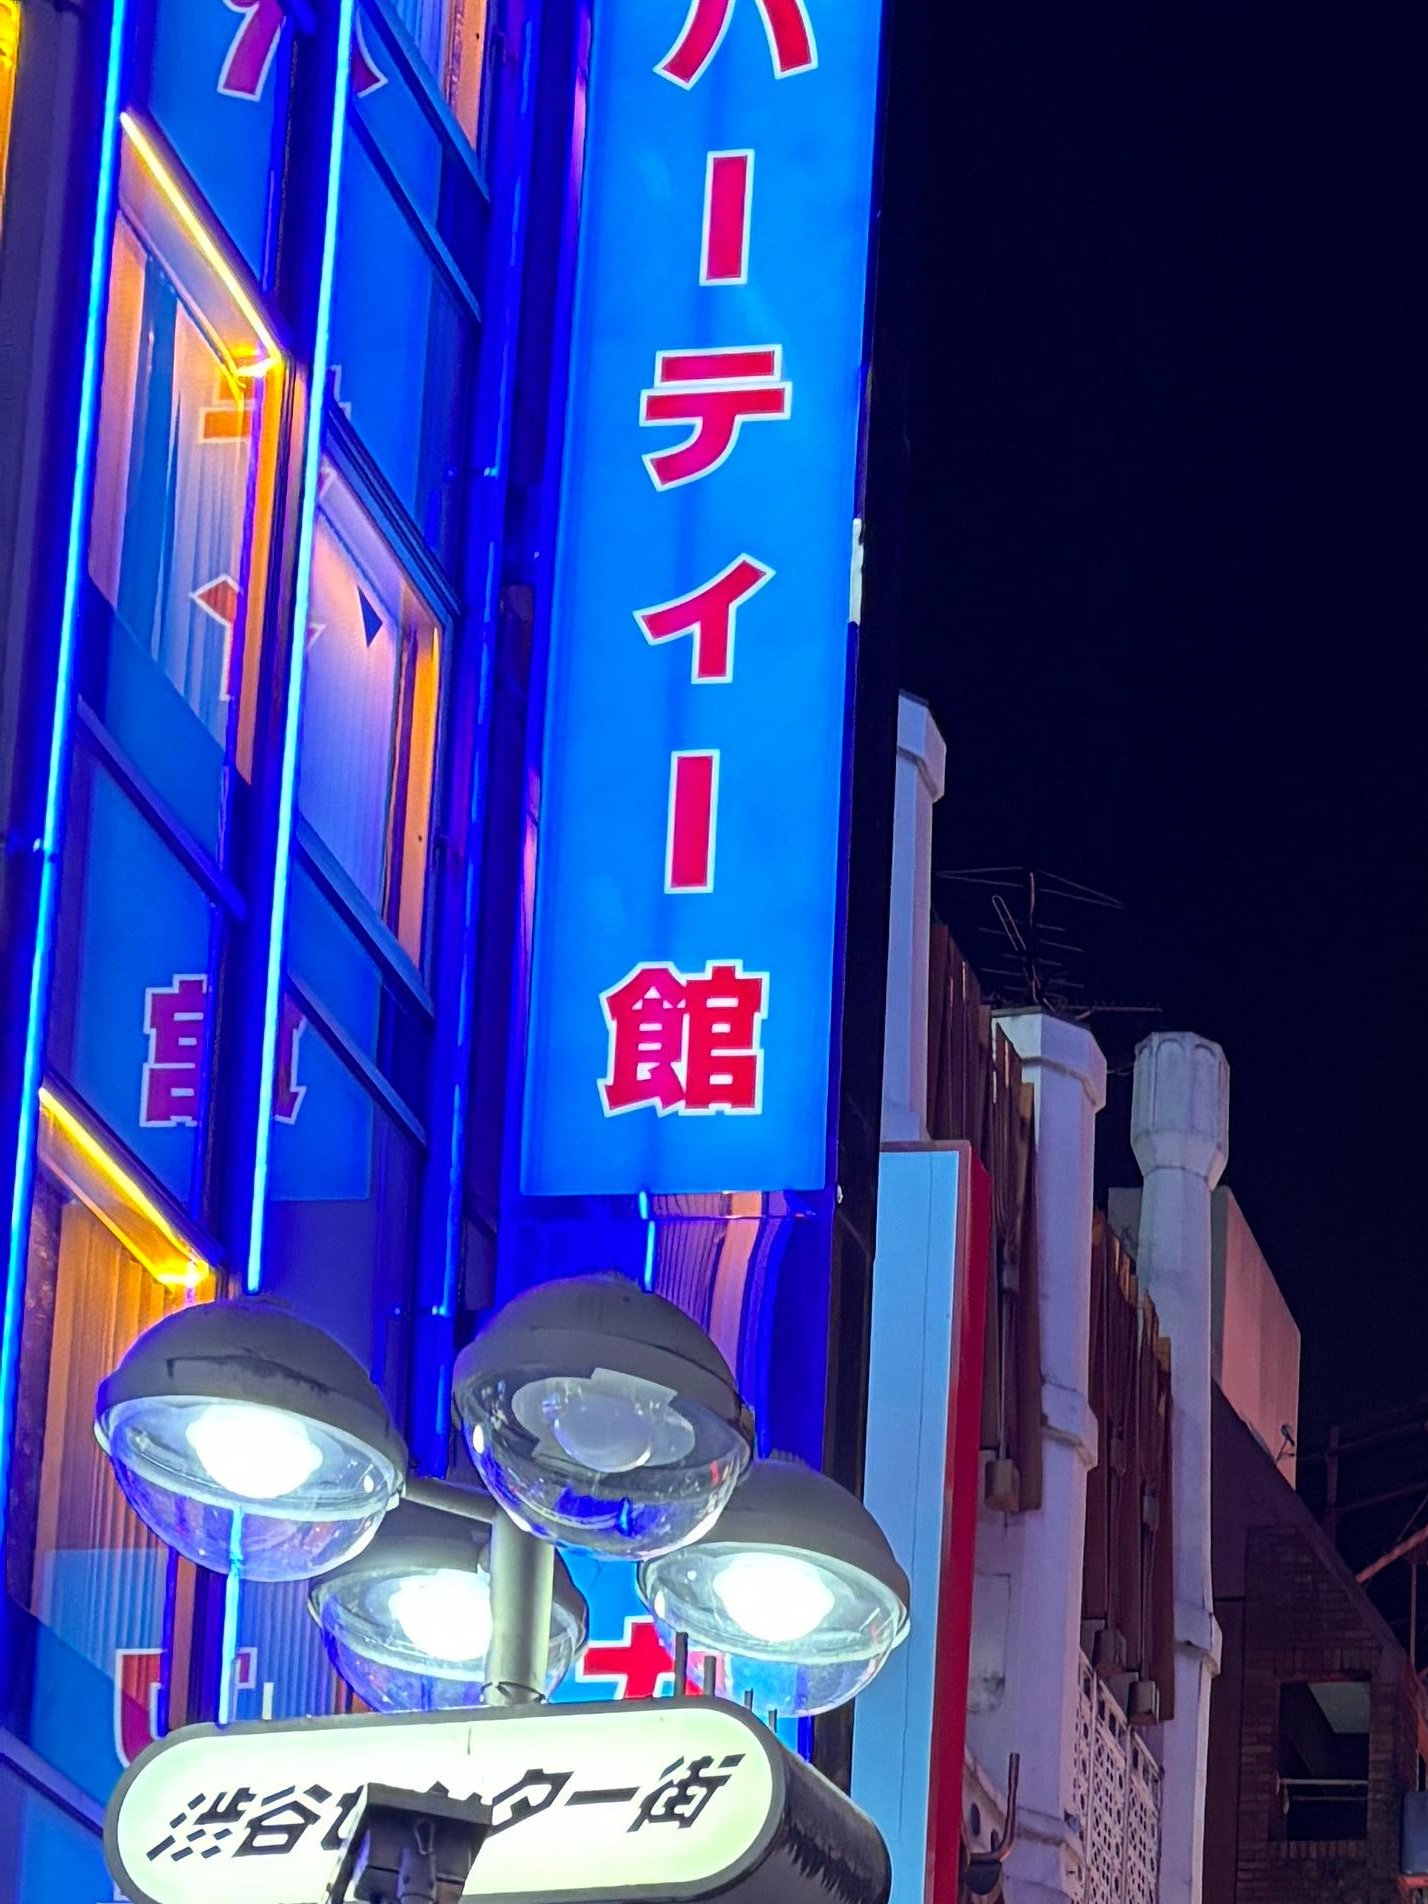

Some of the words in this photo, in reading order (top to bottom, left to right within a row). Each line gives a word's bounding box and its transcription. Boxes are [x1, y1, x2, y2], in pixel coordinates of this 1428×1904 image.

[146, 1753, 745, 1864] 渋谷ター街
